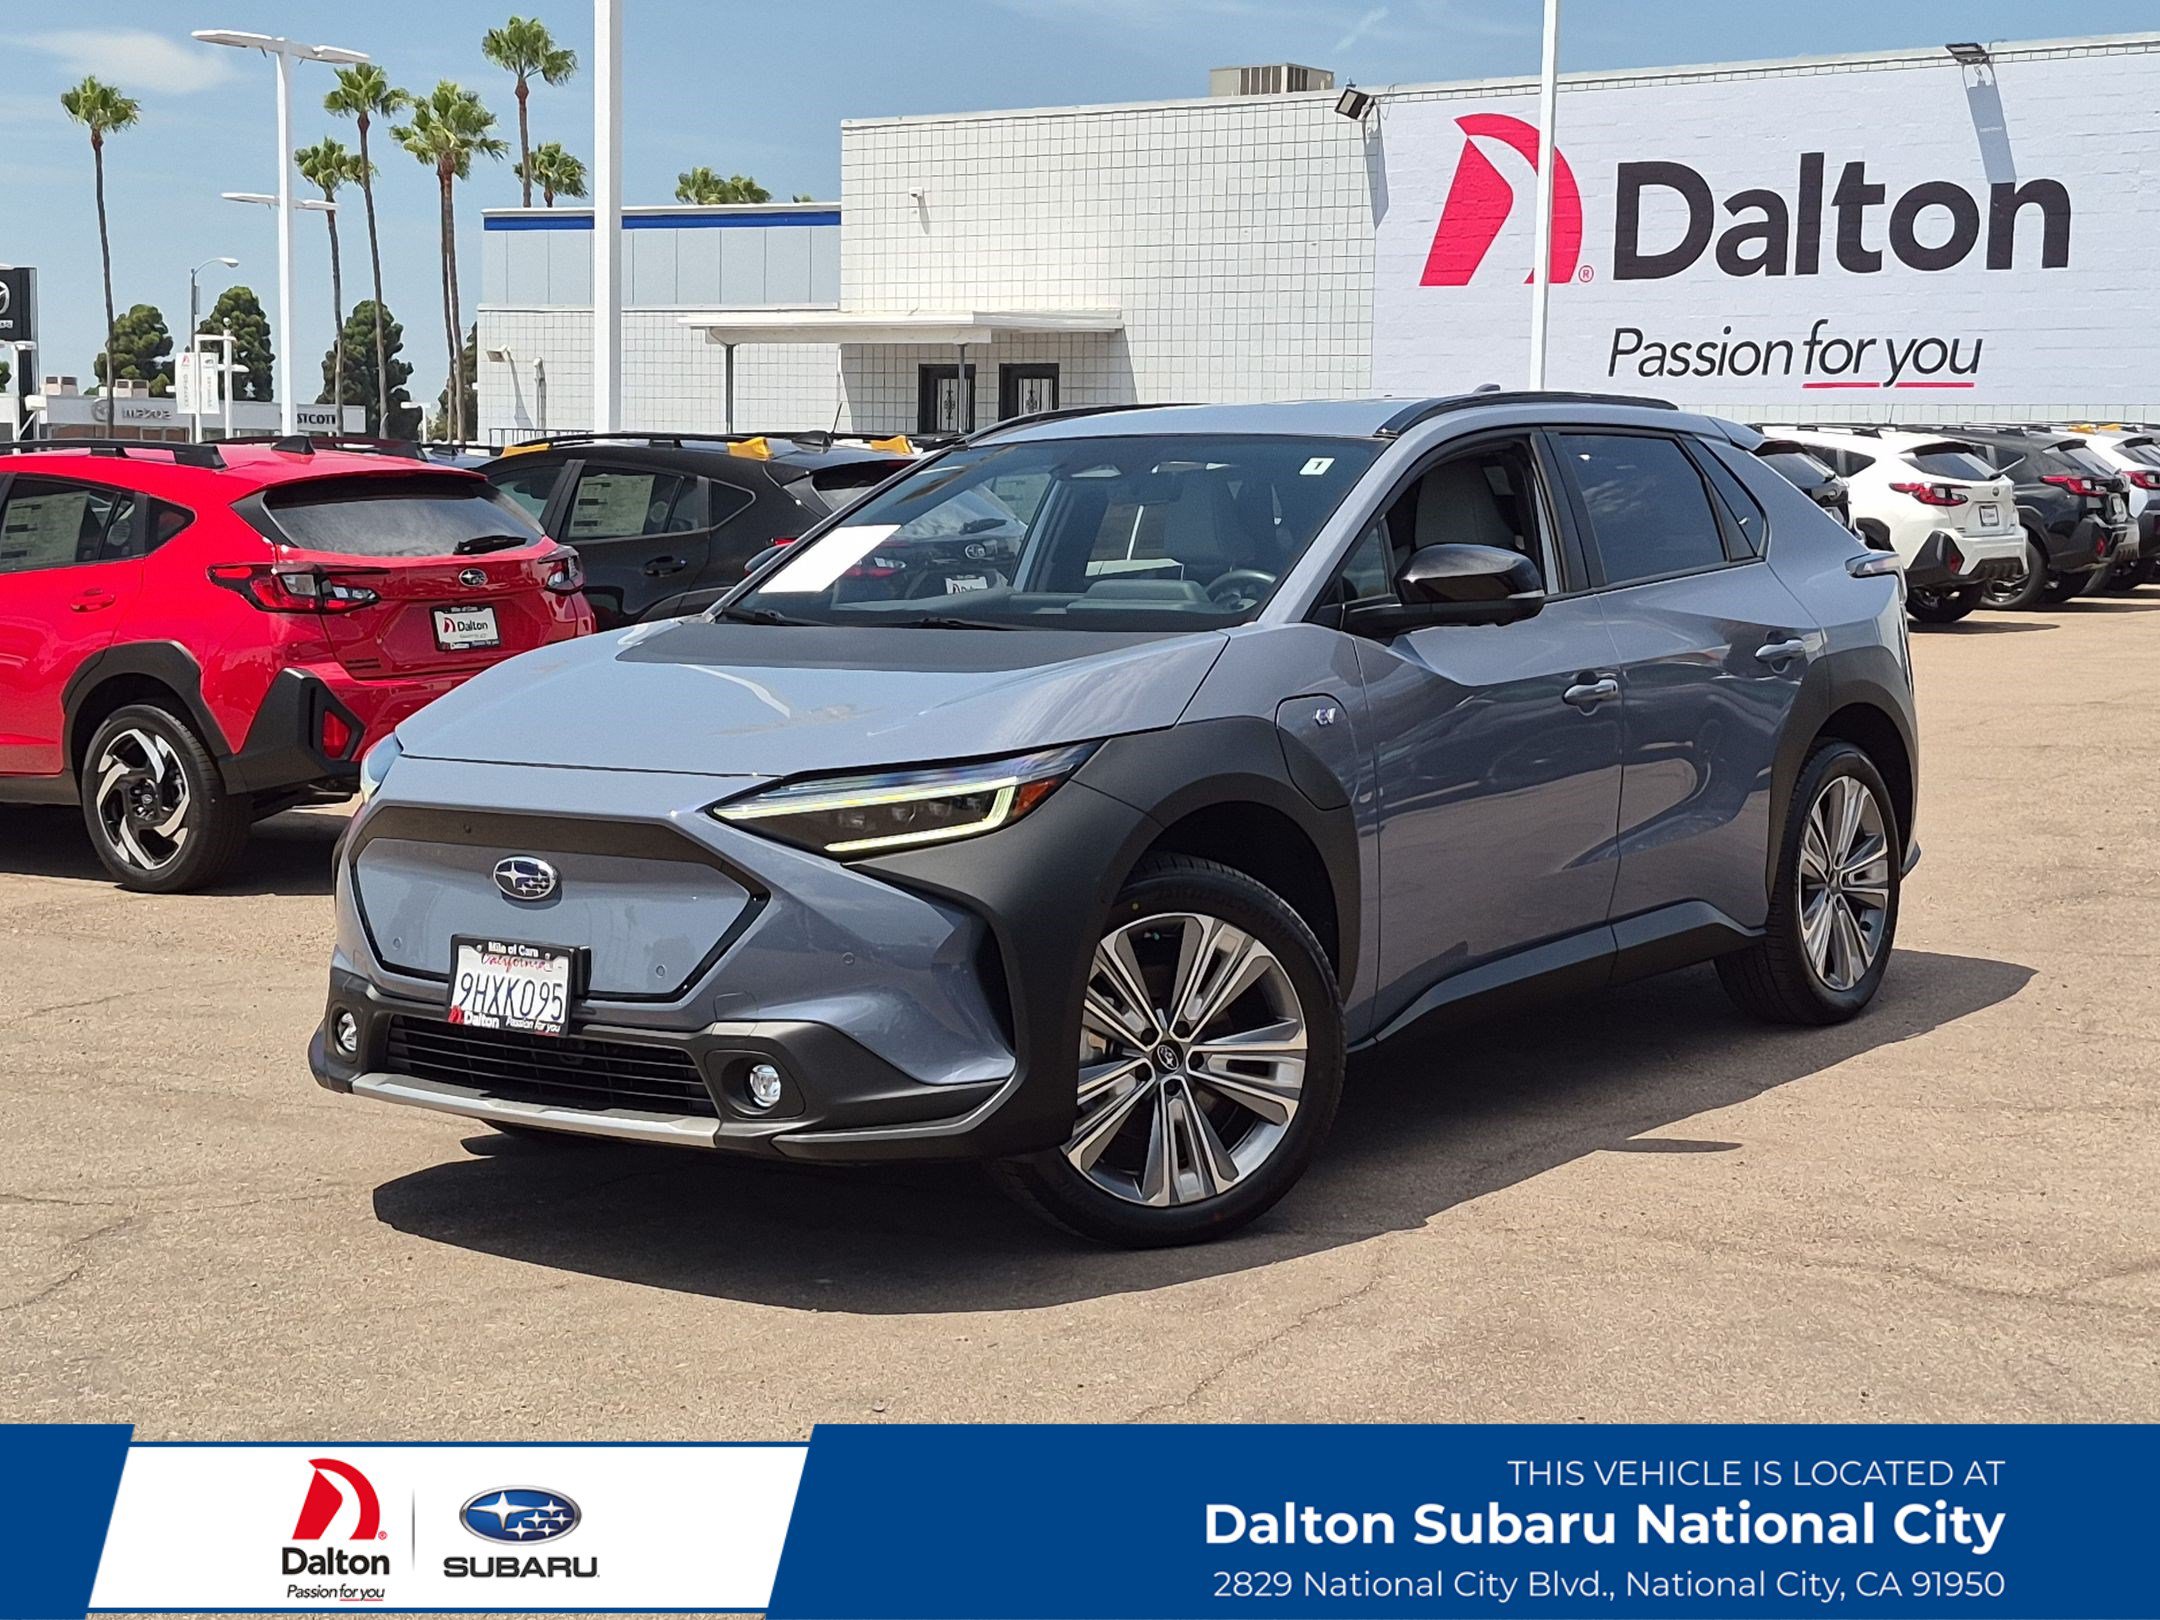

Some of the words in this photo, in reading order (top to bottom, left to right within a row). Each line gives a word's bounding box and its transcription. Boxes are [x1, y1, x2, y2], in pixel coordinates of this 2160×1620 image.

[1613, 151, 2072, 281] Dalton
[1608, 326, 1794, 377] Passion
[1802, 319, 1877, 375] for
[1882, 337, 1983, 388] you
[456, 619, 489, 632] Dalton
[488, 941, 507, 954] Mile
[507, 946, 517, 956] of
[518, 944, 539, 958] Cars
[459, 972, 563, 1021] 9HXK095
[463, 1010, 500, 1030] Dalton
[506, 1015, 534, 1029] Passion
[534, 1019, 545, 1031] for
[545, 1022, 561, 1033] you
